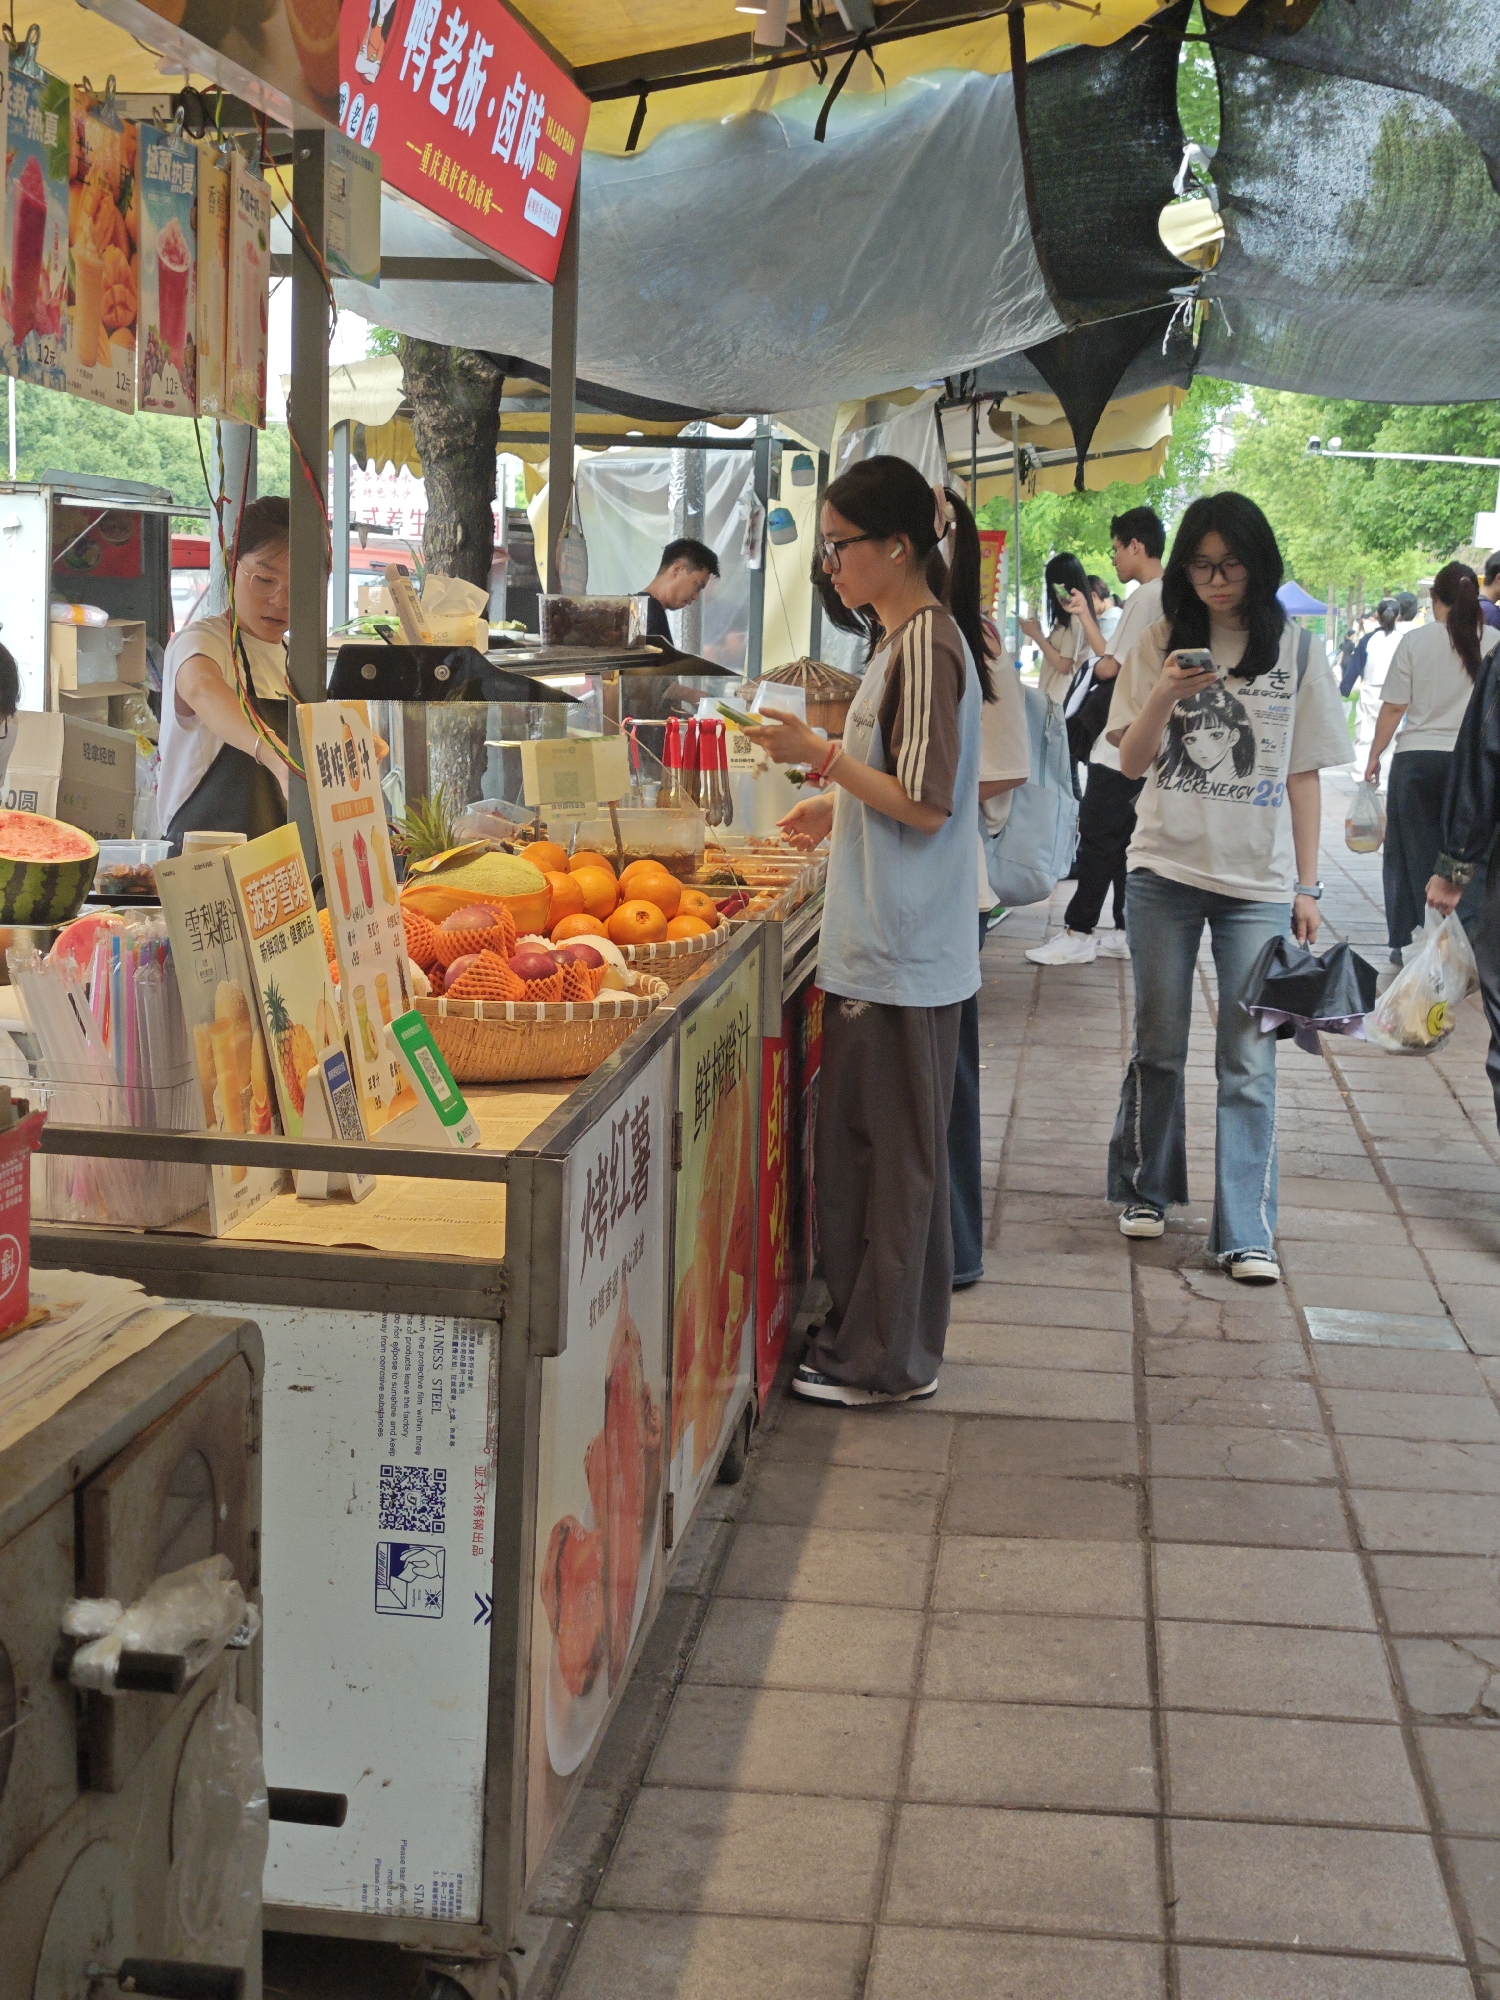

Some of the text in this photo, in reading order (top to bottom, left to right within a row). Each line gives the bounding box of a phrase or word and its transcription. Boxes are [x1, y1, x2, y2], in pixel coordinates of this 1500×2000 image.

[146, 144, 194, 195] 拯救热夏
[418, 143, 494, 216] 重庆最好吃的卤味
[38, 343, 56, 366] 12元
[116, 371, 131, 393] 12元
[165, 377, 178, 395] 12元
[83, 741, 116, 766] 轻拿轻放
[315, 738, 372, 788] 鲜榨果汁
[1156, 776, 1286, 808] BLACKENERGY 23
[246, 858, 308, 932] 菠萝雪梨
[694, 1003, 752, 1140] 鲜榨橙汁
[580, 1095, 651, 1285] 烤红薯
[380, 1336, 388, 1353] from
[390, 1341, 398, 1371] expose
[403, 1336, 411, 1372] products
[378, 1355, 386, 1392] corrosive
[391, 1372, 398, 1380] to
[416, 1351, 424, 1390] protective
[431, 1315, 445, 1415] TAINESS STEEL
[390, 1382, 398, 1418] sunshine
[403, 1373, 411, 1395] leave
[388, 1438, 396, 1457] keep
[471, 1464, 487, 1557] 亚太不锈钢出品
[374, 1857, 382, 1884] Please
